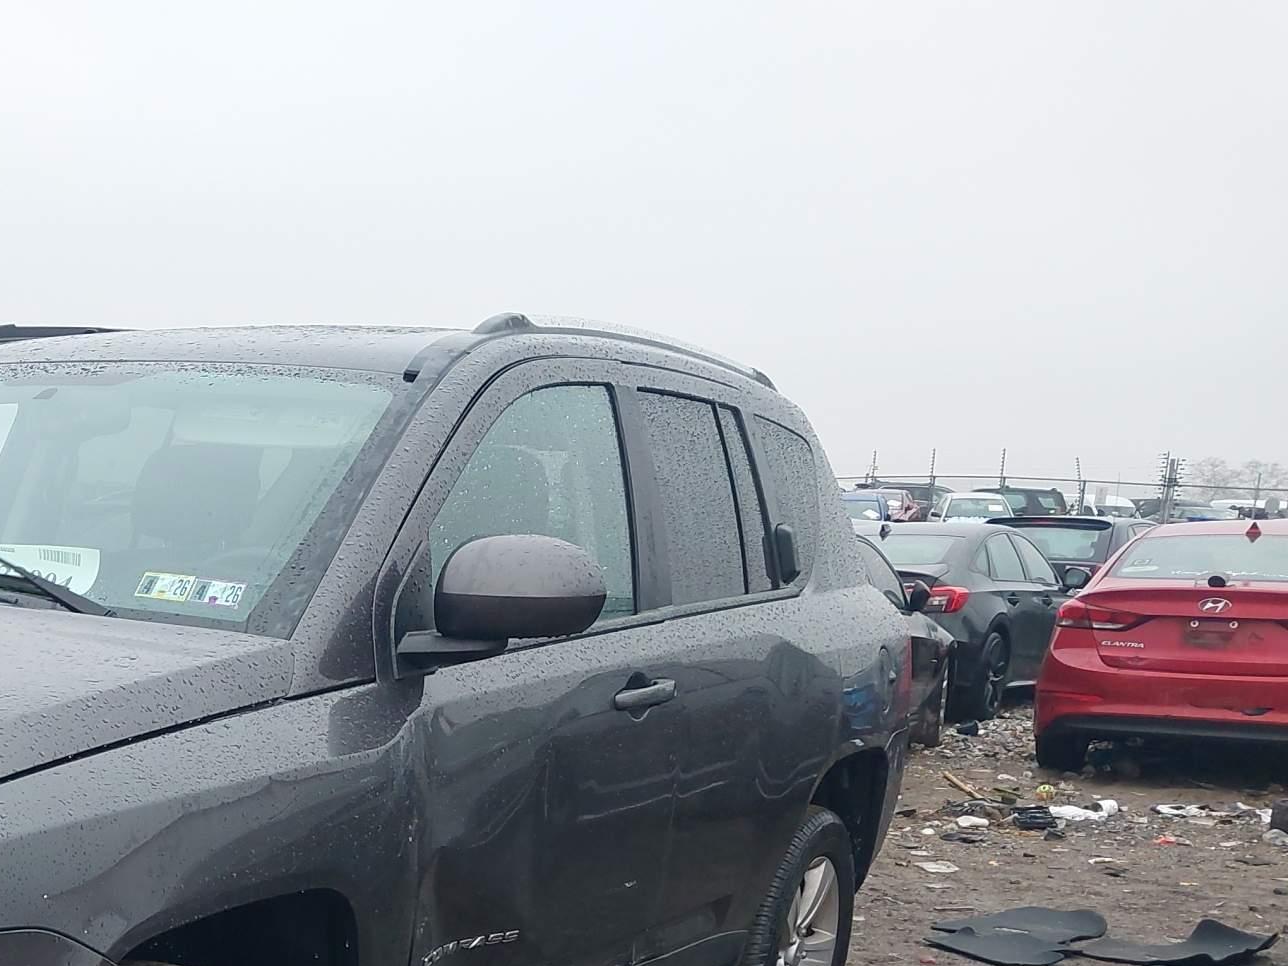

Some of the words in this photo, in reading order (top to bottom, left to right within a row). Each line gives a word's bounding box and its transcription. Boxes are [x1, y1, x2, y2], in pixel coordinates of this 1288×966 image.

[173, 579, 190, 596] 26
[225, 585, 242, 603] 26
[1101, 640, 1145, 649] ELANTRA
